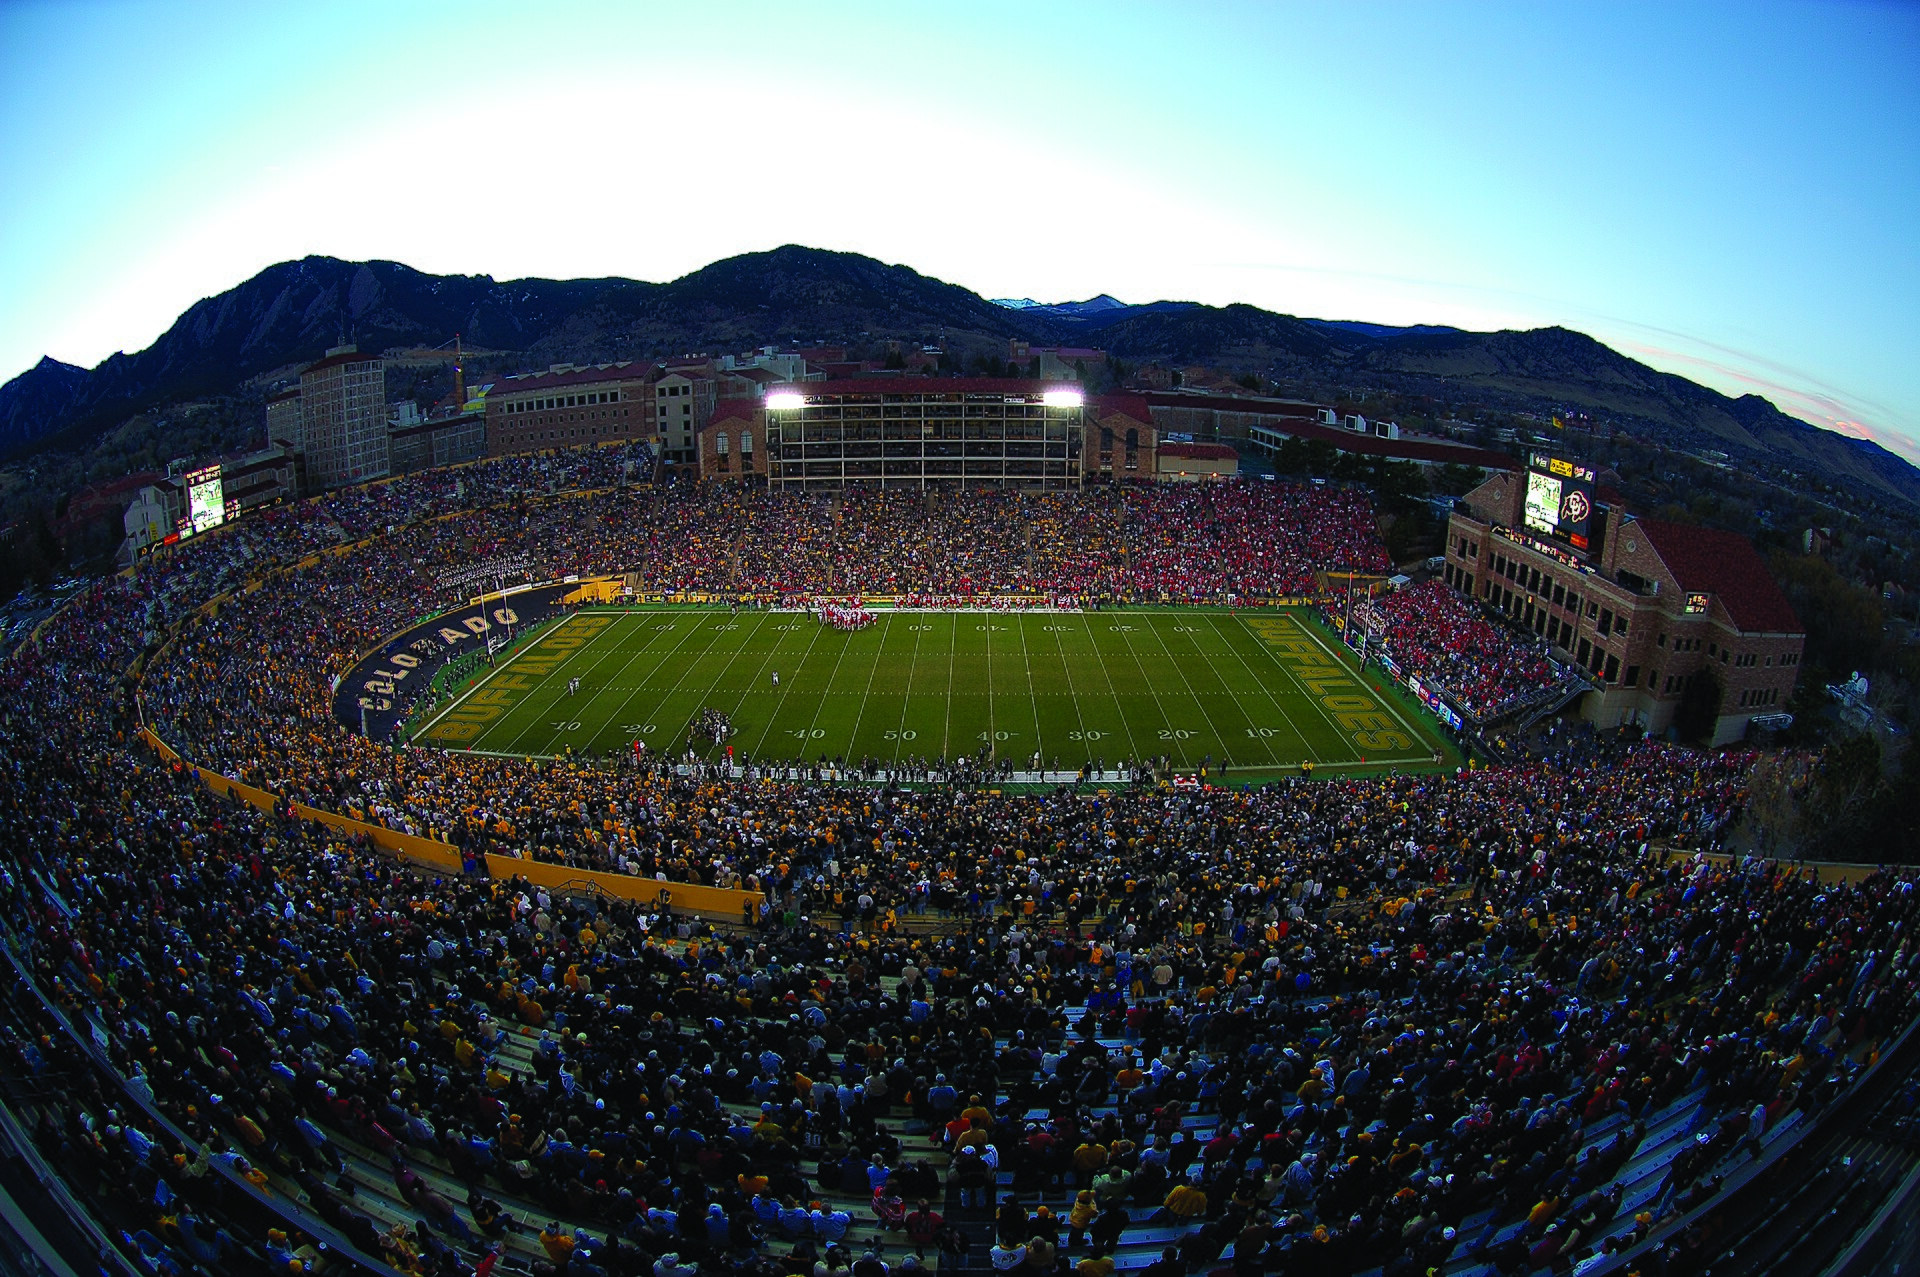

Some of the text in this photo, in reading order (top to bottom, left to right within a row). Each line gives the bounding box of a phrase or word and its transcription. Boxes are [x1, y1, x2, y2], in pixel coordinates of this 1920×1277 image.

[424, 616, 613, 742] BUFFALOES
[1243, 618, 1414, 751] BUFFALOES
[555, 721, 582, 731] 10
[625, 724, 657, 734] 20
[793, 729, 826, 739] 40
[883, 730, 917, 740] 50
[976, 731, 1009, 741] 40
[1069, 730, 1101, 741] 30
[1157, 729, 1190, 740] 20
[1244, 727, 1273, 739] 10
